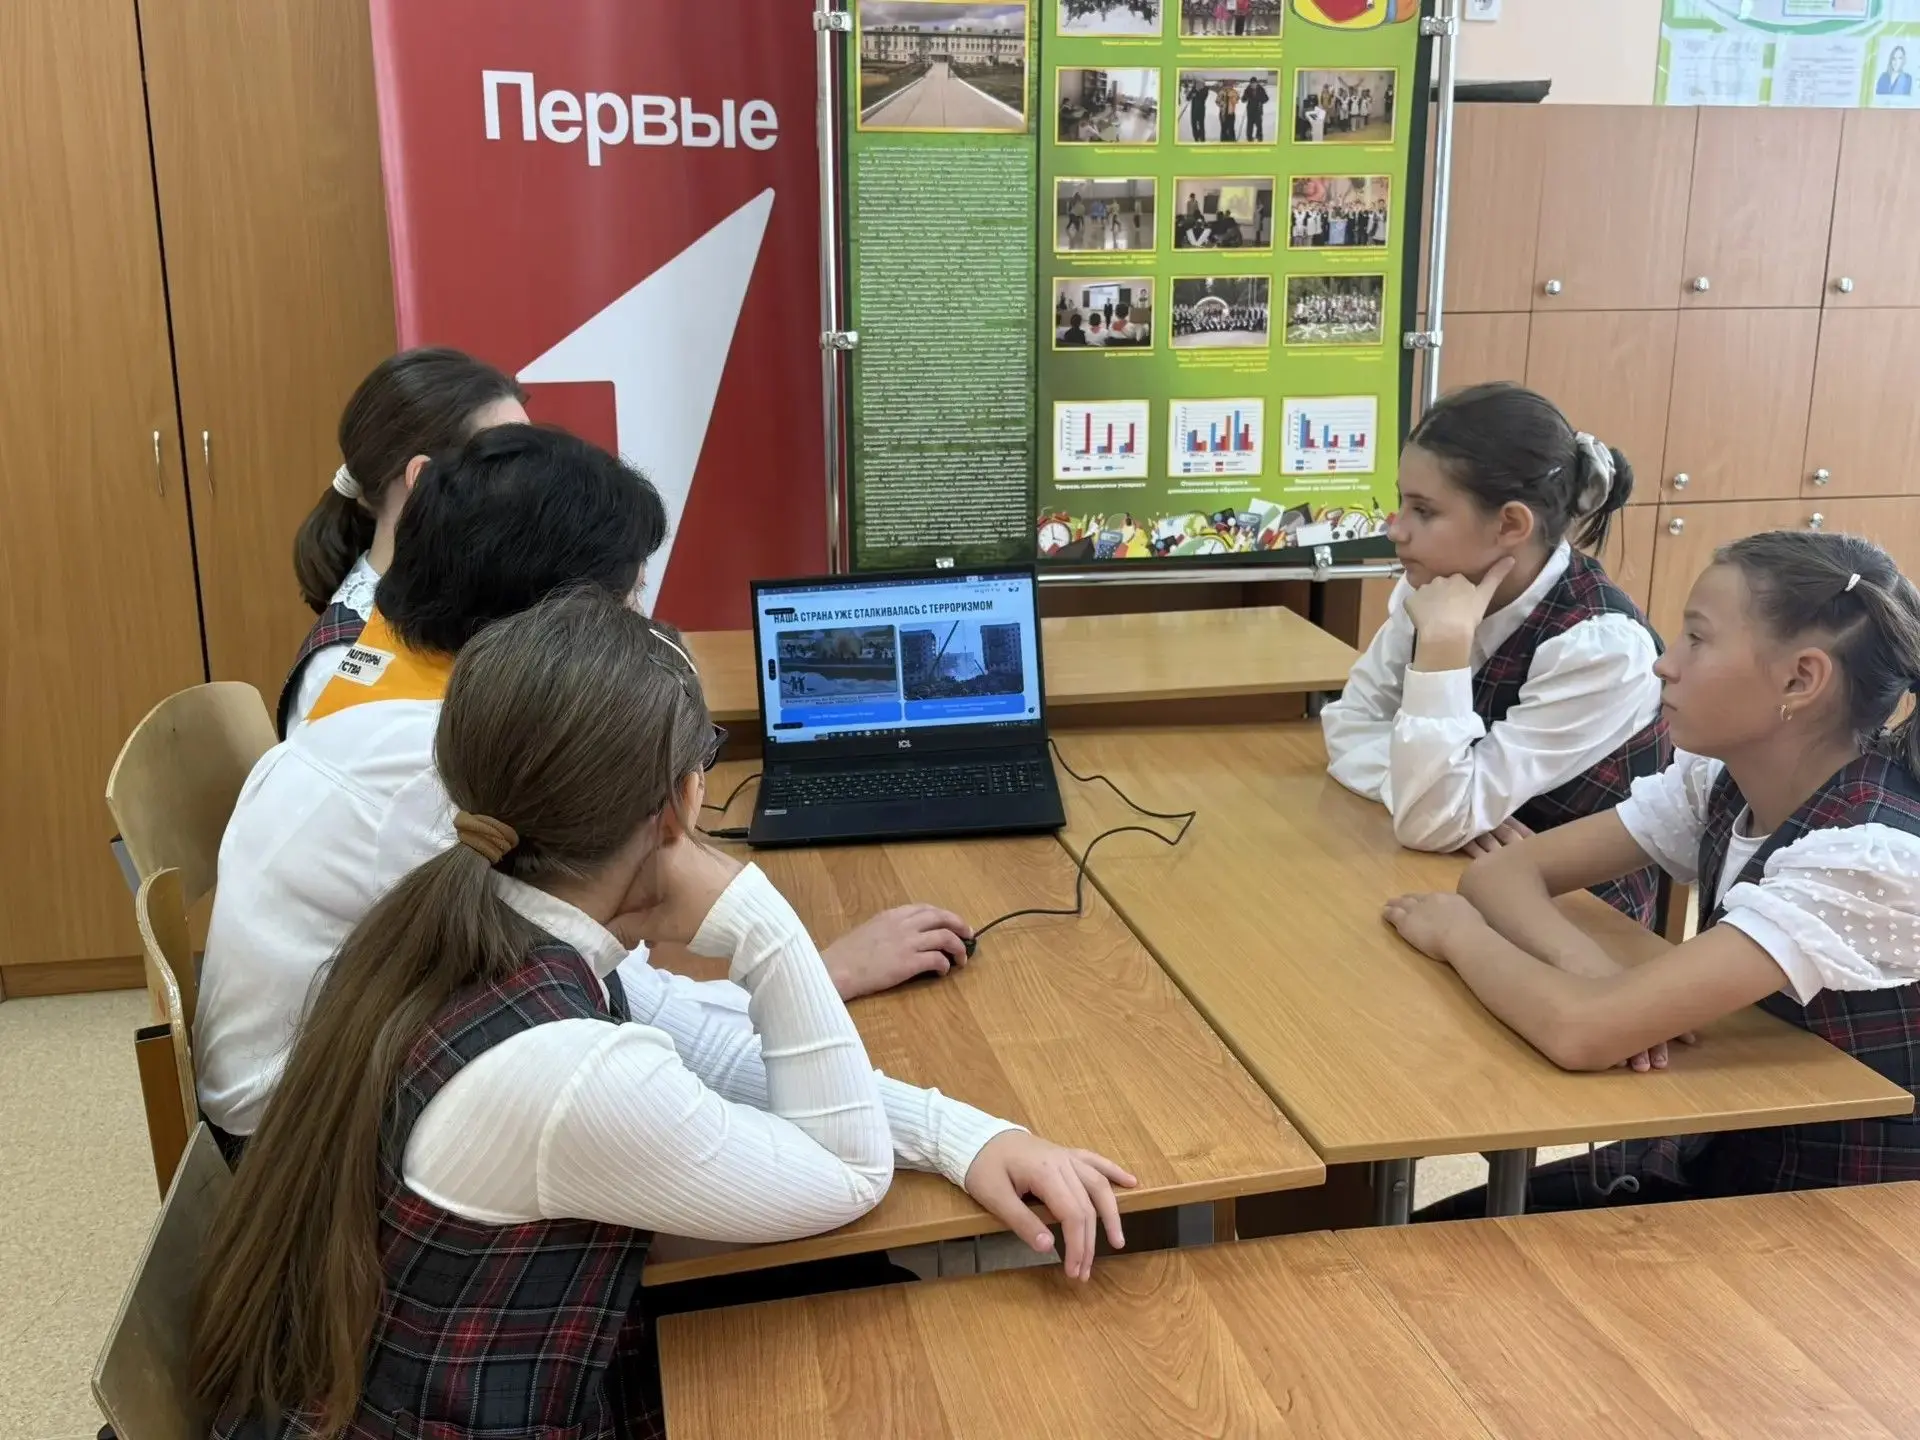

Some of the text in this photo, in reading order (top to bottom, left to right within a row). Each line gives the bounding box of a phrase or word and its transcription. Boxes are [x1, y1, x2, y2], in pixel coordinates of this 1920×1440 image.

[482, 70, 778, 166] Первые
[774, 600, 993, 624] НАША СТРАНА УЖЕ СТАЛКИВАЛАСЬ С ТЕРРОРИЗМОМ
